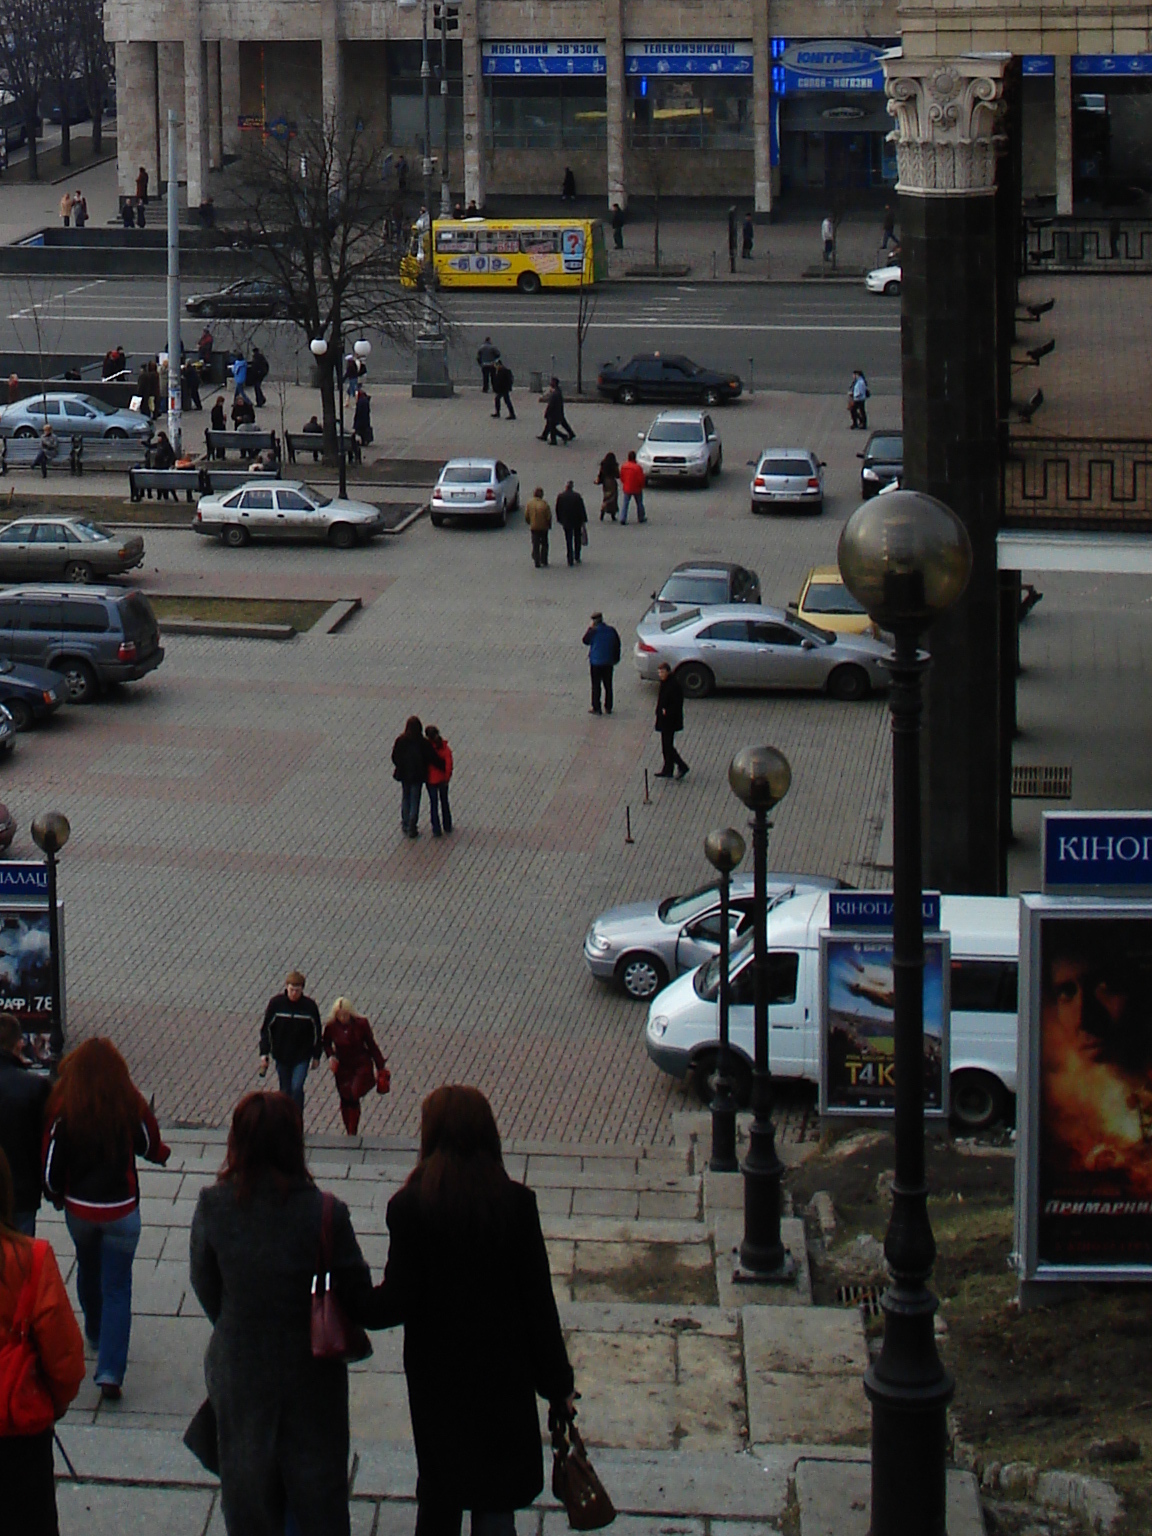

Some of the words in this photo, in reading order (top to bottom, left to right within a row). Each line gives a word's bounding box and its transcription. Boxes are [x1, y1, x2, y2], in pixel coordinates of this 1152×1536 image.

[490, 42, 548, 55] МОБІЛЬНИЙ
[556, 43, 599, 54] ЗВ'ЯЗОК
[643, 43, 736, 56] ТЕЛЕКОМУНІКАЦІЇ
